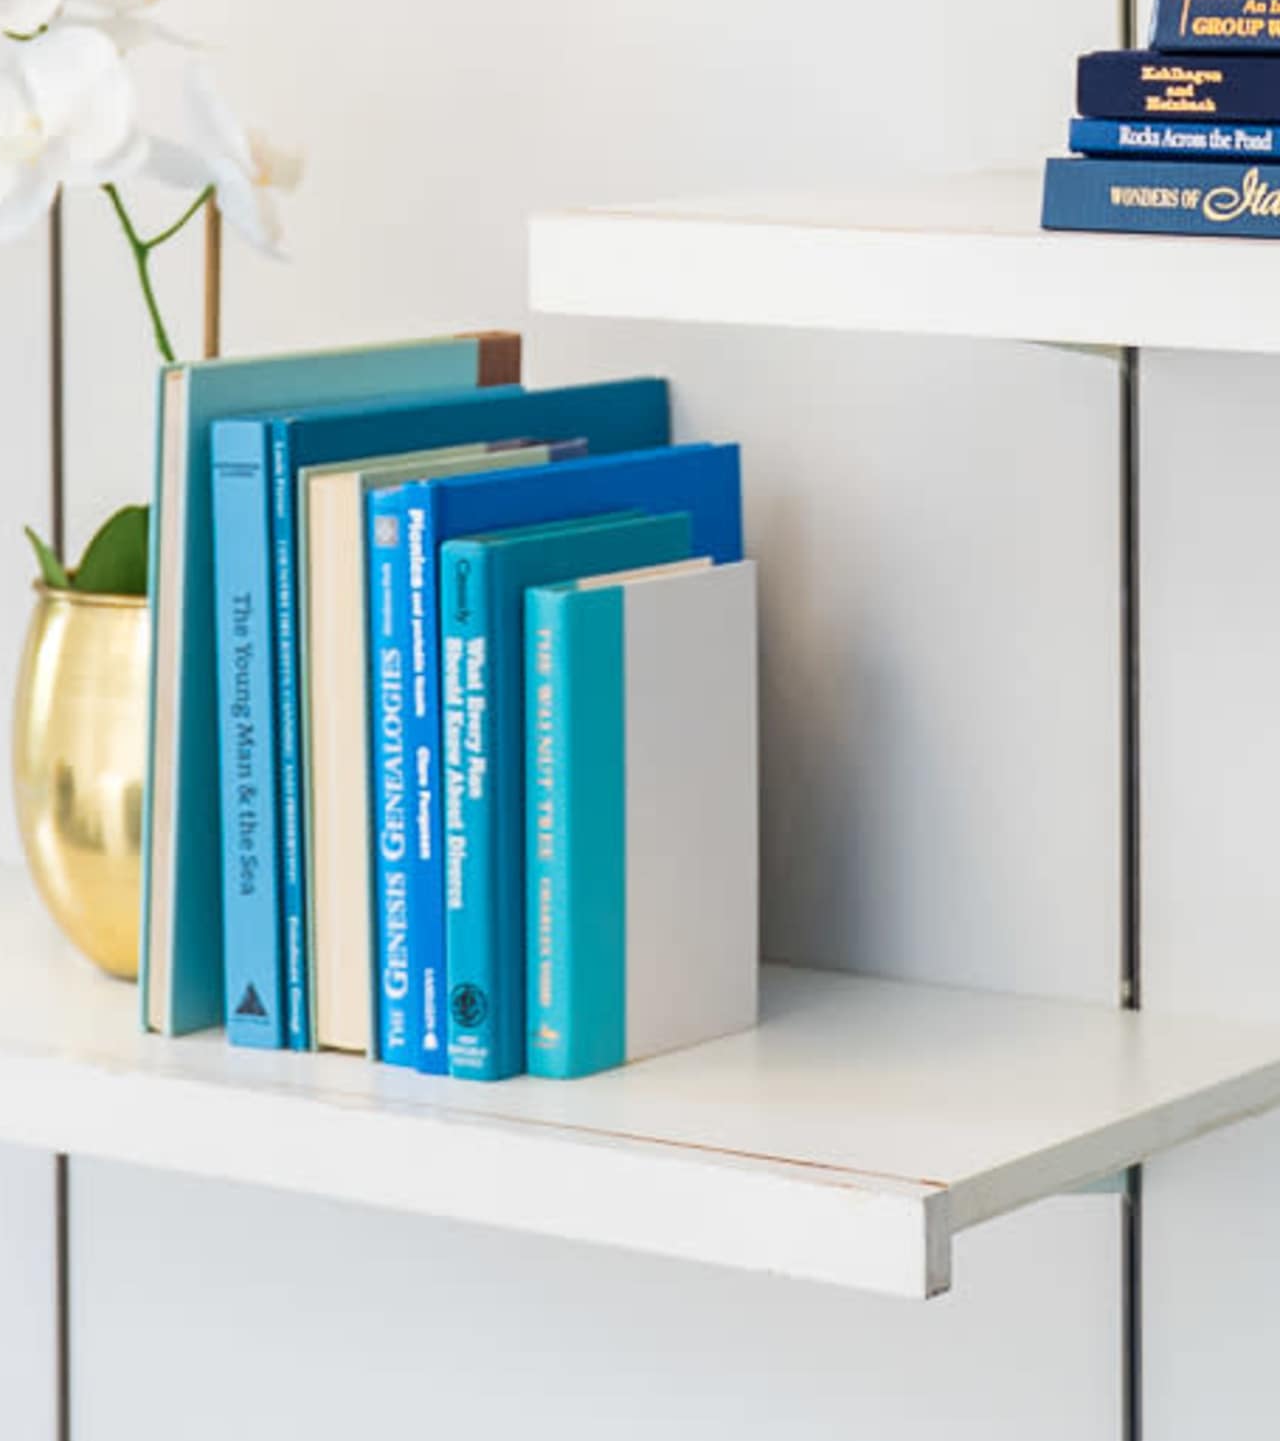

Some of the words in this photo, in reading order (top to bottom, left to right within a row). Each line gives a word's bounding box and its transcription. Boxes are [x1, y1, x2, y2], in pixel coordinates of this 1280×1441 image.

[1191, 16, 1265, 37] GROUP
[1165, 83, 1196, 99] and
[1118, 125, 1162, 147] Rocks
[1162, 127, 1208, 148] Across
[1208, 128, 1234, 149] the
[1234, 129, 1274, 152] Pond
[1109, 184, 1180, 208] WONDERS
[1181, 186, 1202, 210] OF
[407, 507, 426, 589] Picnics
[233, 591, 253, 639] The
[411, 591, 424, 617] and
[231, 643, 255, 719] Young
[444, 636, 464, 706] Should
[466, 636, 486, 690] What
[236, 723, 256, 780] Man
[445, 710, 464, 766] Know
[464, 696, 487, 753] Every
[536, 684, 554, 789] WALNUT
[381, 648, 407, 861] GENEALOGIES
[467, 755, 487, 799] Man
[237, 784, 258, 806] &
[446, 767, 465, 830] About
[239, 810, 259, 853] the
[537, 799, 554, 862] TREE
[240, 855, 260, 898] Sea
[446, 834, 467, 910] Divorce
[384, 872, 409, 1001] GENESIS
[386, 1010, 406, 1050] THE
